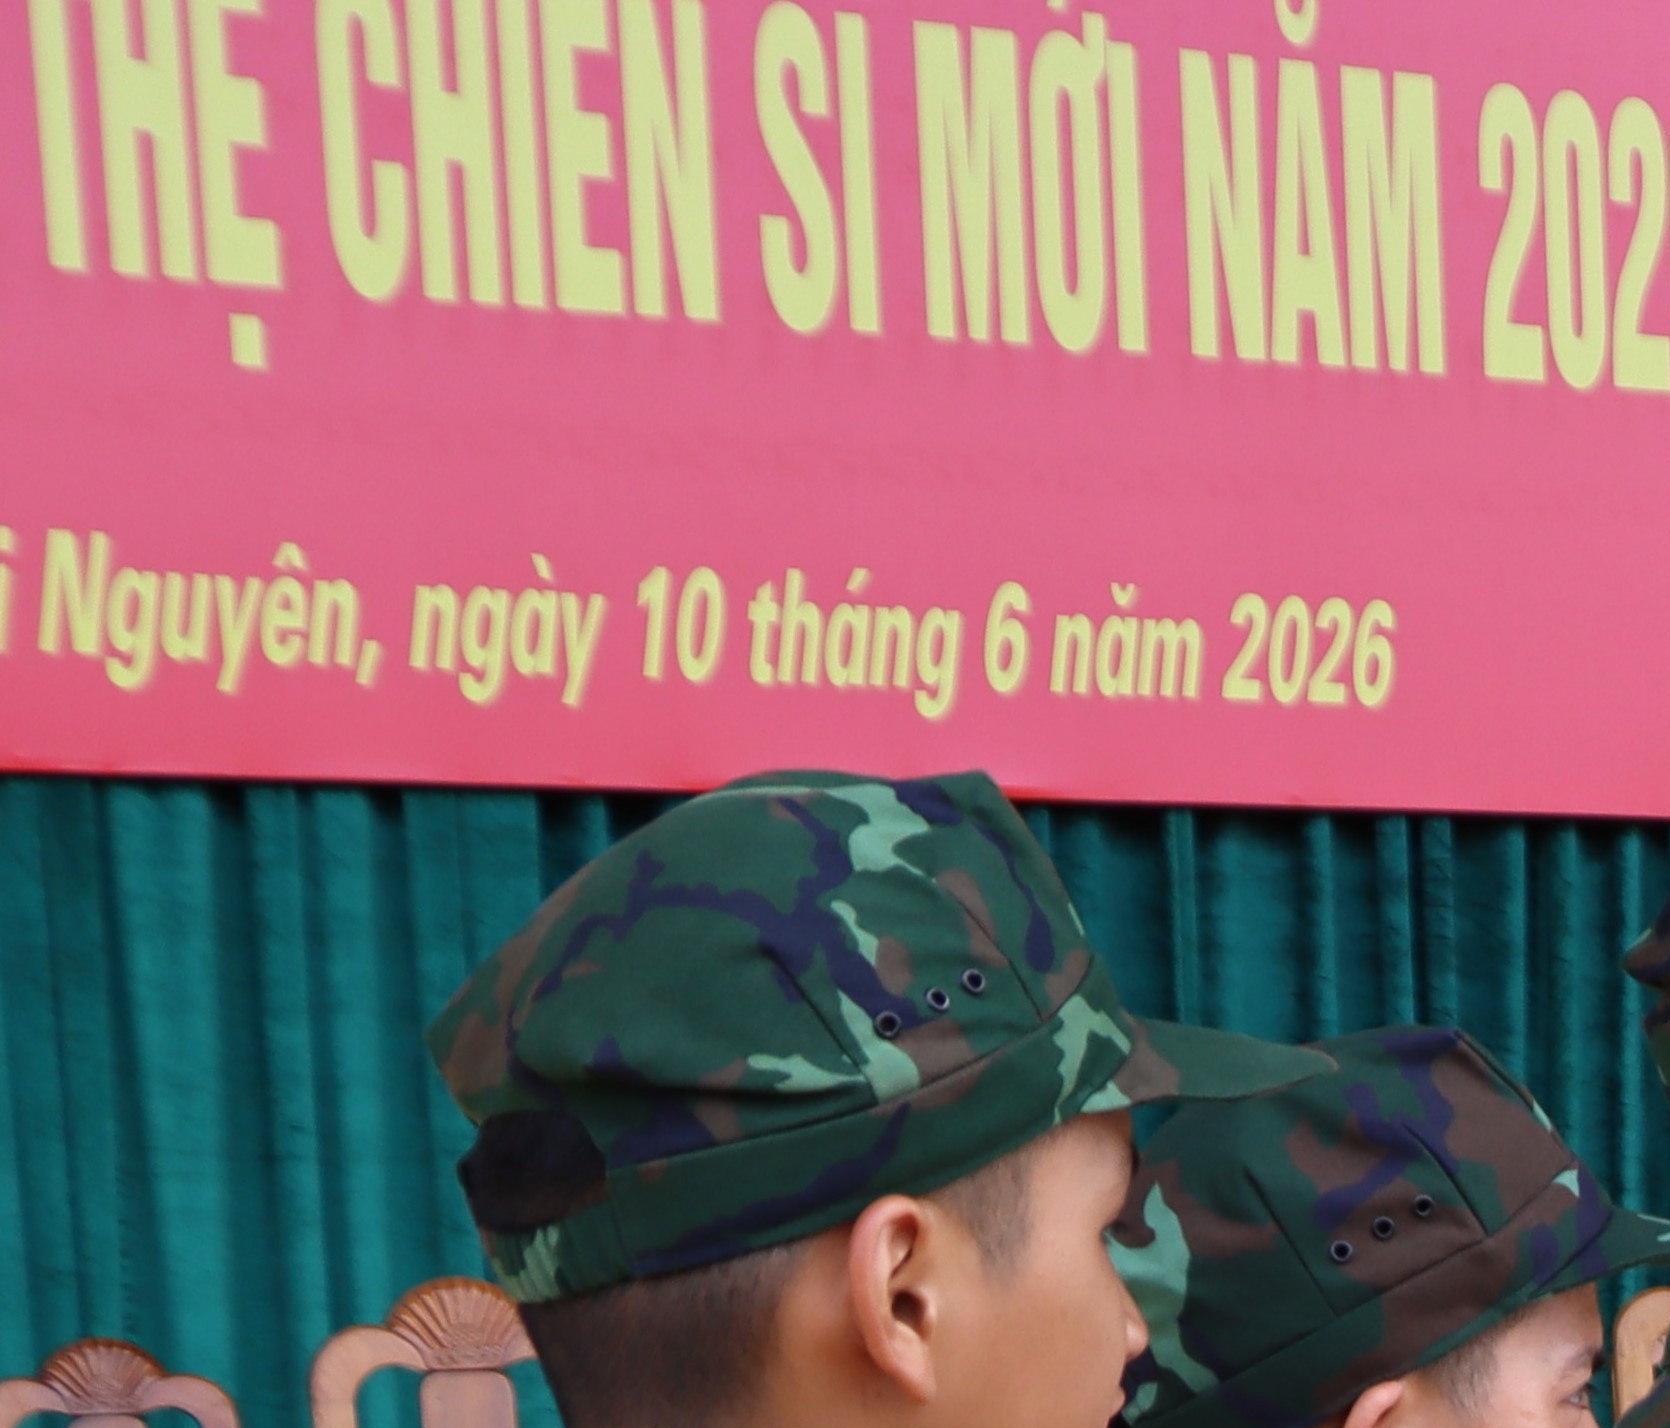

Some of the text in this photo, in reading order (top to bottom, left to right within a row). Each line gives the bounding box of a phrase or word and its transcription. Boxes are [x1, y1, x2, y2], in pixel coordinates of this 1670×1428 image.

[1178, 0, 1445, 375] NĂM
[38, 527, 384, 694] Nguyên,
[408, 552, 607, 707] ngày
[636, 566, 726, 682] 10
[747, 567, 962, 720] tháng
[983, 580, 1030, 693] 6
[1049, 581, 1203, 697] năm
[1221, 592, 1395, 706] 2026
